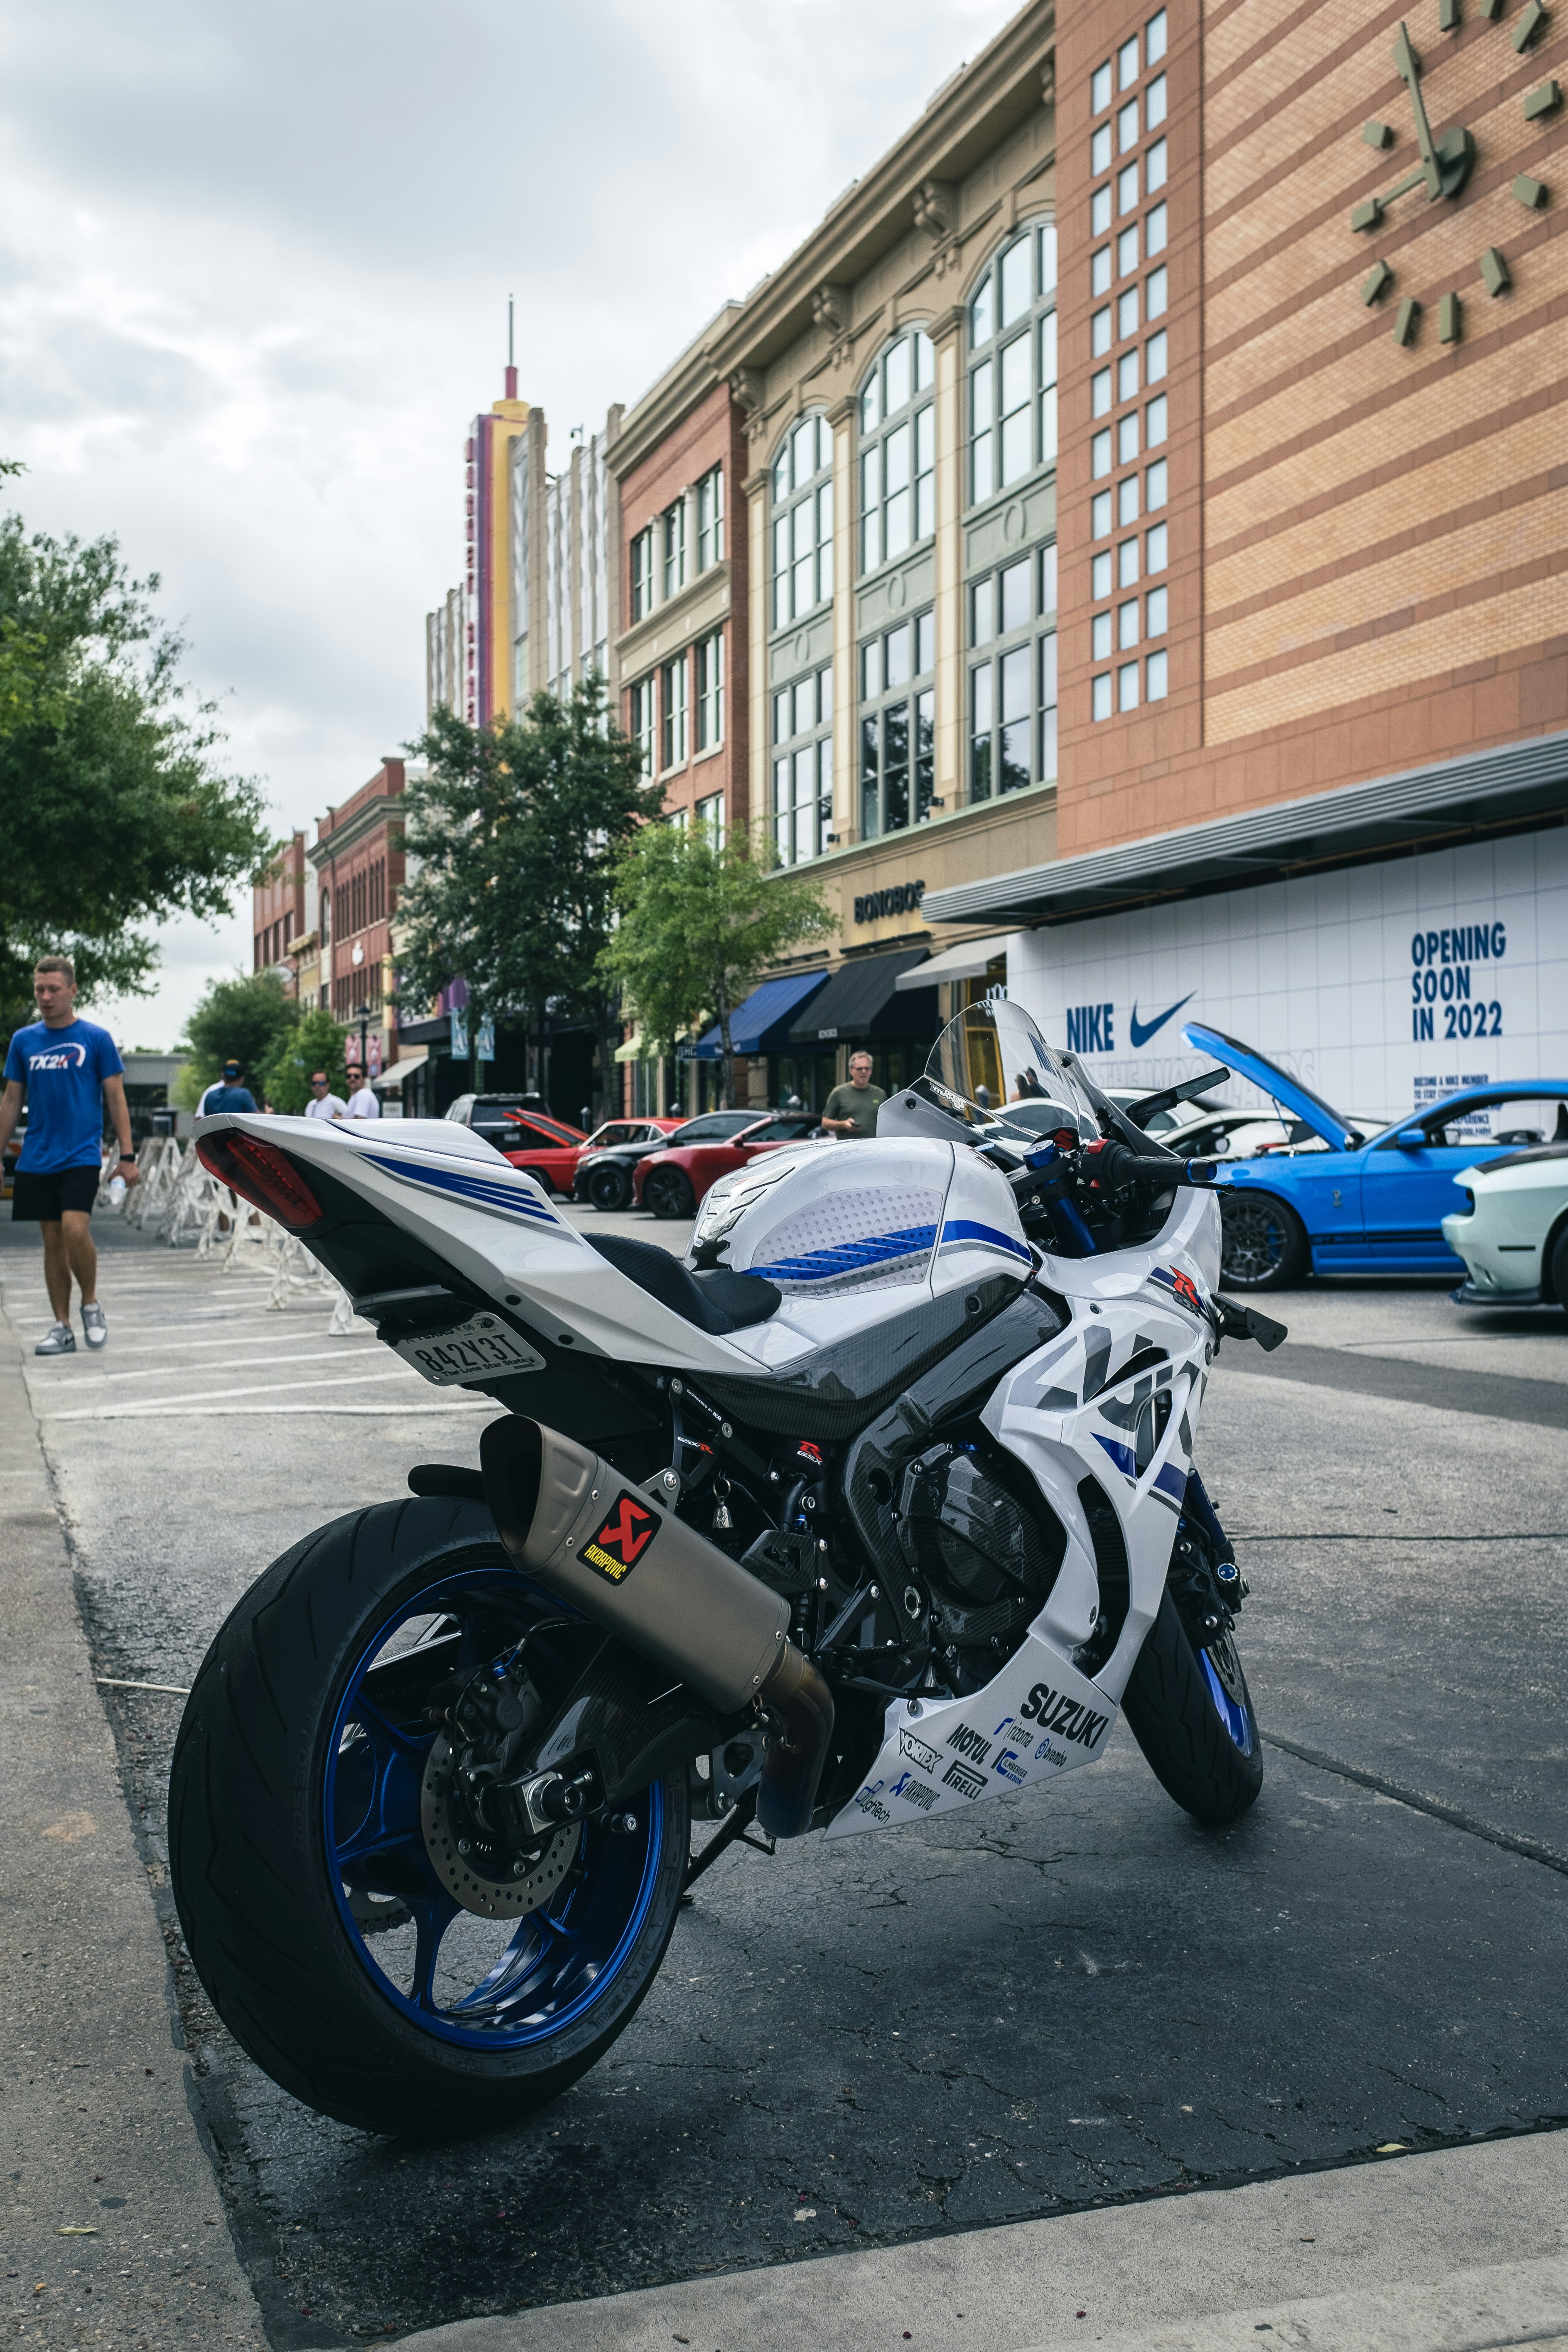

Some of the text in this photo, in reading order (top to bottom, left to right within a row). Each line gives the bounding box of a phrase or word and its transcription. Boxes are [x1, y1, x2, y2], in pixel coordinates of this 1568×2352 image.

[854, 879, 925, 925] BONOBOS
[1412, 922, 1506, 967] OPENING
[1412, 965, 1470, 1004] SOON
[1067, 1003, 1114, 1053] NIKE
[1413, 1001, 1502, 1041] IN 2022
[1174, 1292, 1200, 1317] GSX
[415, 1334, 523, 1371] 842Y3T
[460, 1365, 483, 1373] Lone
[502, 1357, 527, 1366] State
[797, 1451, 822, 1465] GSX
[1007, 1721, 1034, 1748] rizoma
[1020, 1683, 1109, 1749] SUZUKI
[899, 1727, 944, 1775] VORTEX
[946, 1722, 992, 1765] MOTUL
[1042, 1743, 1067, 1767] brembo
[941, 1759, 989, 1800] PIRELLI
